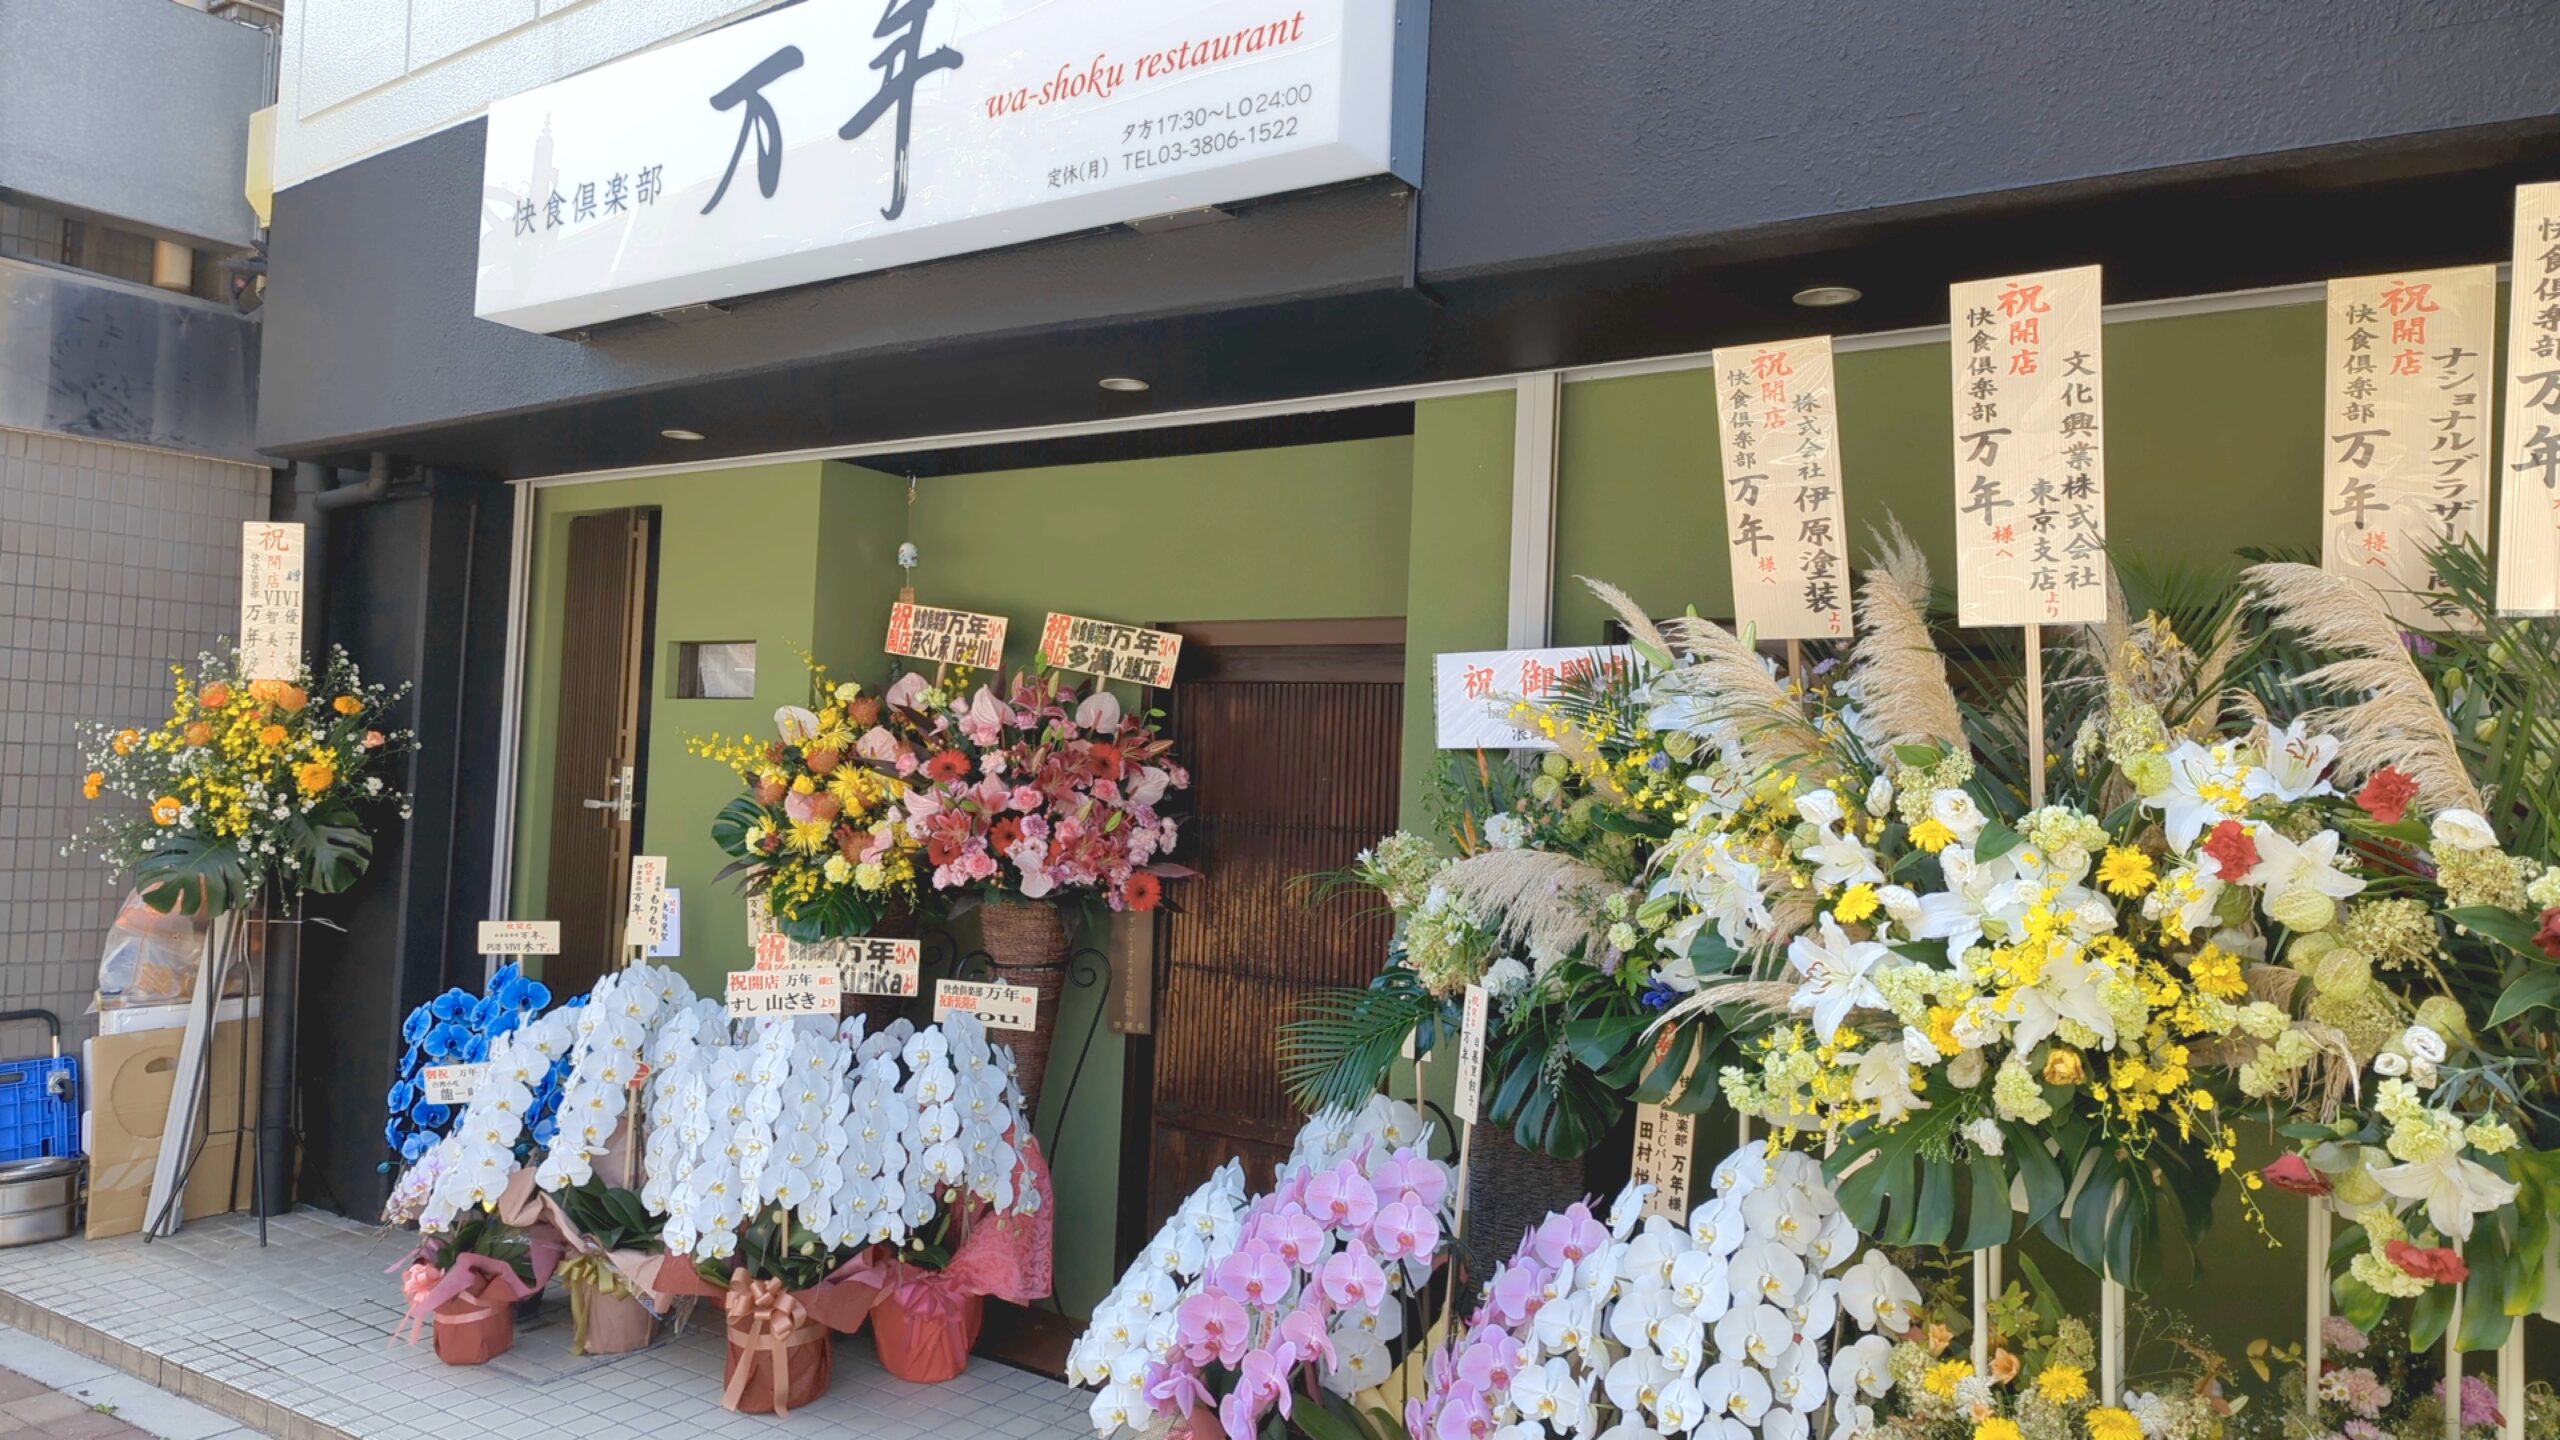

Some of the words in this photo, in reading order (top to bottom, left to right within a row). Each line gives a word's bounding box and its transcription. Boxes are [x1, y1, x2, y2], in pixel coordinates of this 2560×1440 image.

[985, 54, 1127, 120] wa-shoku
[1133, 9, 1306, 83] restaurant
[700, 0, 965, 221] 万年
[511, 163, 665, 239] 快食倶楽部
[263, 589, 301, 607] VIVI
[1463, 664, 1496, 700] 祝
[729, 974, 780, 992] 祝開店
[785, 973, 813, 987] 万年
[730, 997, 759, 1013] すし
[766, 992, 816, 1011] 山ざき
